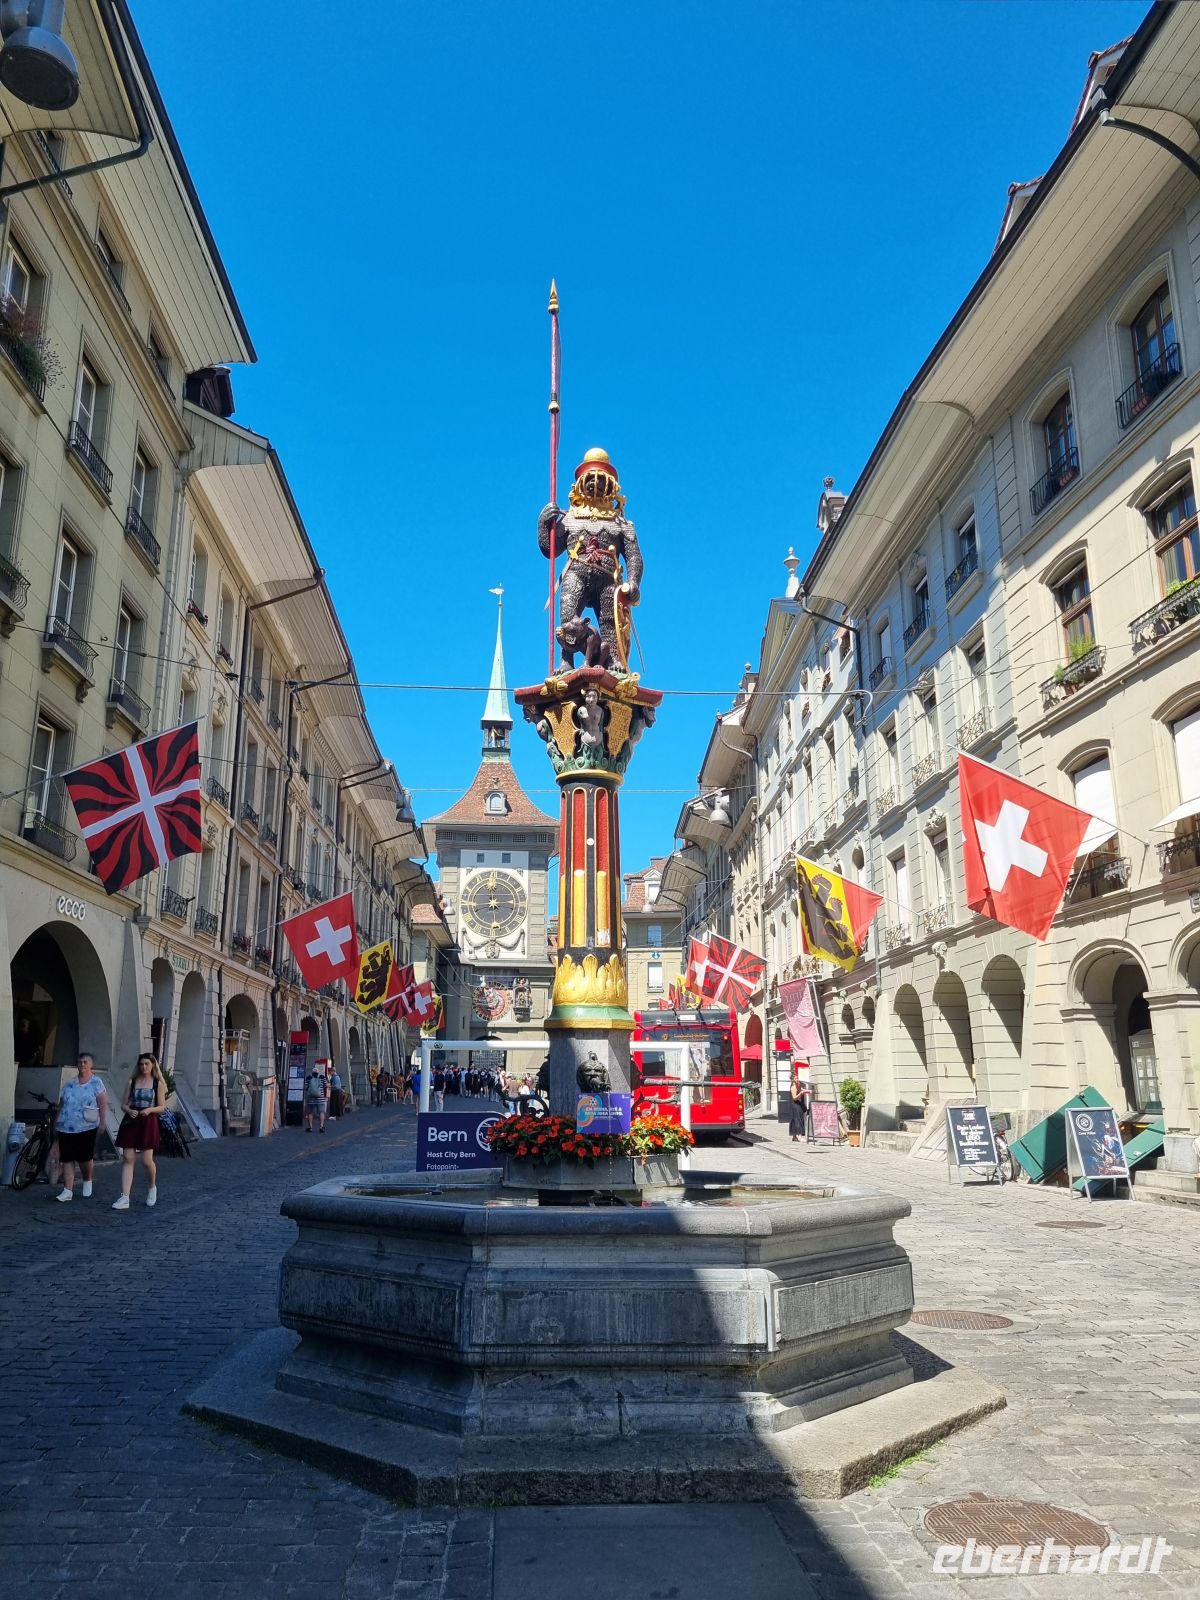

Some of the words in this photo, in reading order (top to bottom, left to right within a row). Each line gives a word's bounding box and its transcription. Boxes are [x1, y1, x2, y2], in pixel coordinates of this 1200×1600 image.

[58, 896, 86, 920] ecco
[427, 1127, 467, 1142] Bern
[444, 1151, 458, 1159] City
